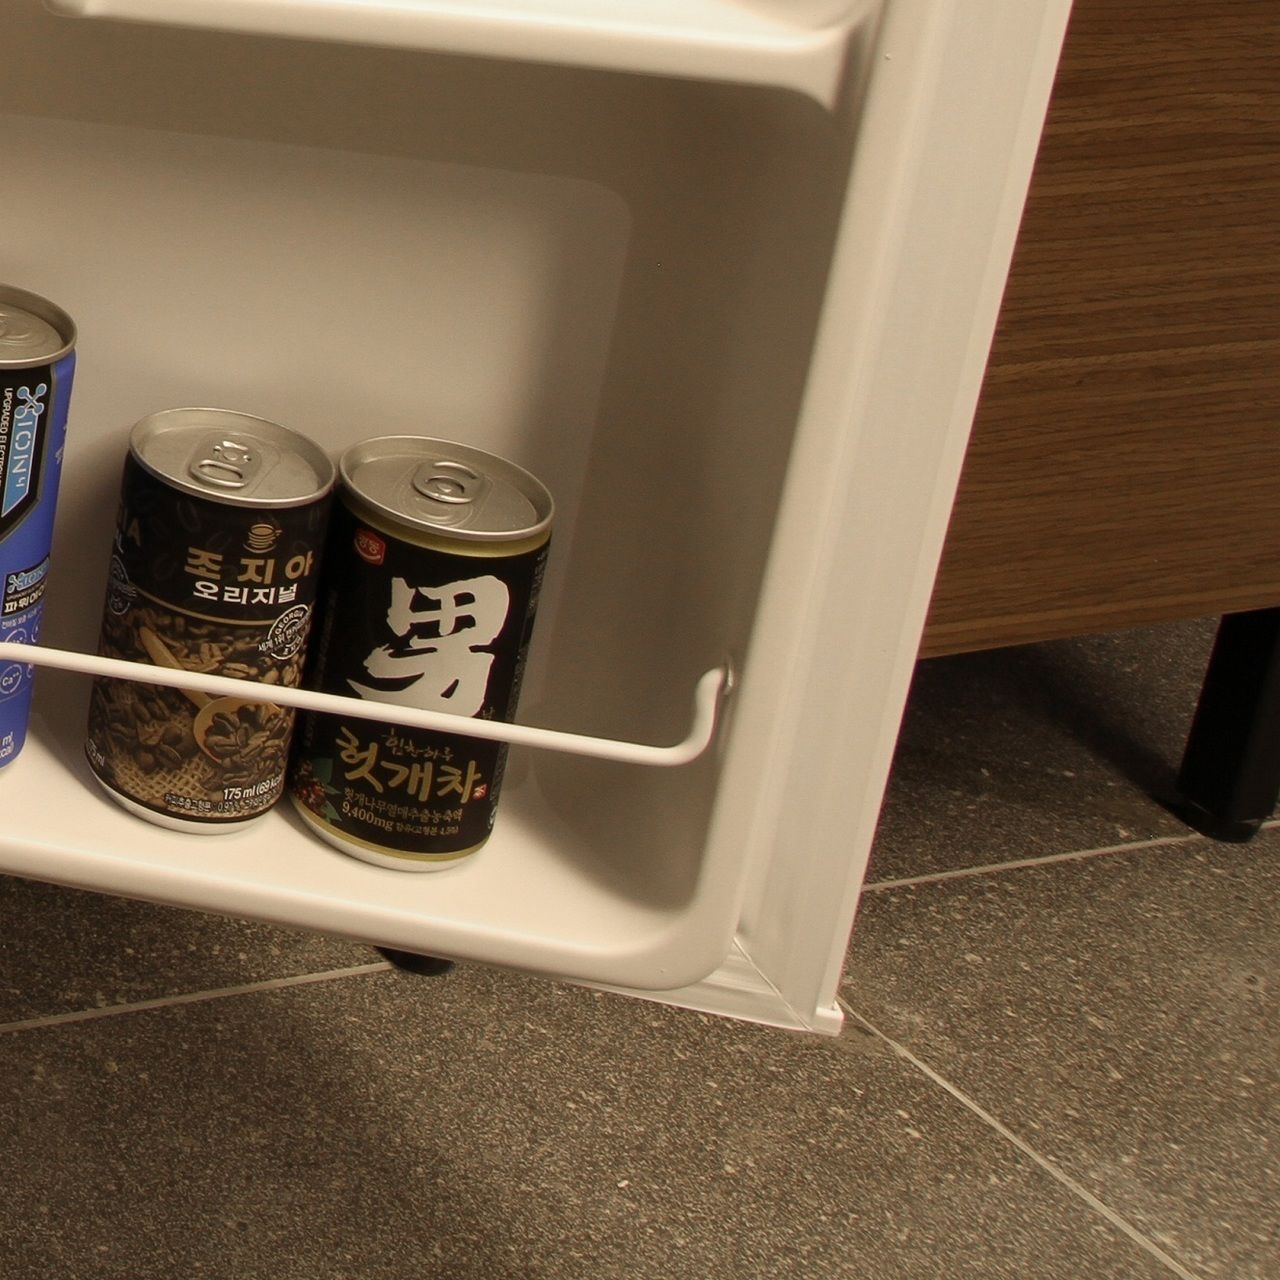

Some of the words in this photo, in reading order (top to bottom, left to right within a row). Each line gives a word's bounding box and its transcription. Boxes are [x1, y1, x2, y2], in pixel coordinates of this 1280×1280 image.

[0, 387, 14, 434] UPGRADED
[183, 546, 315, 585] 조지아
[192, 580, 299, 606] 오리지널
[345, 574, 511, 718] 男
[1, 731, 14, 749] ml
[335, 724, 482, 805] 헛개차
[223, 786, 242, 801] 175
[242, 784, 256, 799] ml
[256, 778, 272, 797] (69
